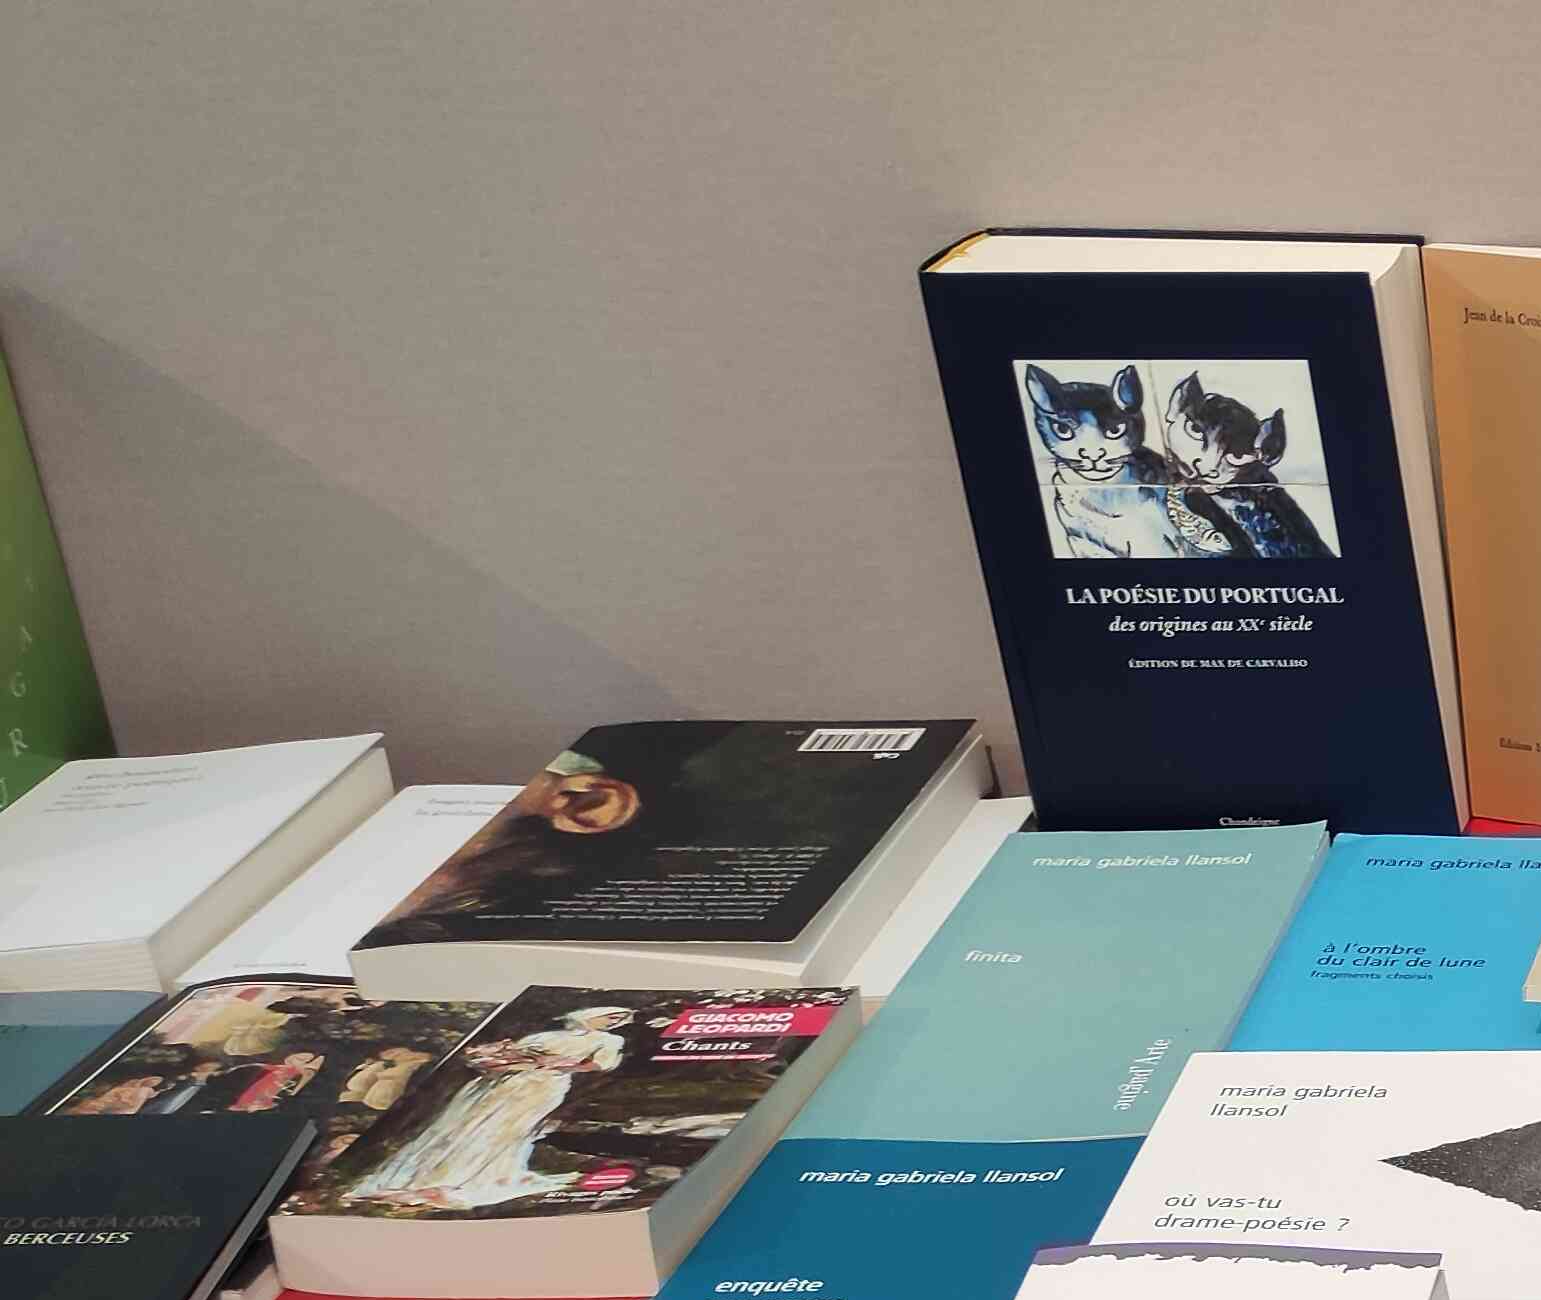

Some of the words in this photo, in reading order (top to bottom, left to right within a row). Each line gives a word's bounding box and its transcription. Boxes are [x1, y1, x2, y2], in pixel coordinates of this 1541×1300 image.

[1066, 588, 1097, 603] LA
[1100, 584, 1181, 603] POÉSIE
[1184, 588, 1216, 603] DU
[1221, 587, 1344, 603] PORTUGAL
[1033, 855, 1089, 866] maria
[1097, 854, 1179, 870] gabriela
[1186, 853, 1252, 866] llansol
[1322, 943, 1335, 954] à
[1344, 943, 1426, 955] l'ombre
[964, 950, 1023, 963] finita
[1317, 956, 1343, 966] du
[1353, 956, 1398, 967] clair
[1406, 956, 1431, 967] de
[1439, 956, 1487, 967] lune
[688, 1012, 794, 1023] GIACOMO
[676, 1023, 792, 1034] LEOPARDI
[663, 1039, 752, 1052] Chants
[1219, 1085, 1286, 1098] maria
[1294, 1084, 1388, 1101] gabriela
[1210, 1104, 1287, 1118] llansol
[800, 1168, 870, 1183] maria
[875, 1168, 976, 1186] gabriela
[983, 1168, 1064, 1183] llansol
[1164, 1194, 1196, 1208] où
[1206, 1197, 1281, 1210] vas-tu
[1154, 1214, 1326, 1232] drame-poésie
[3, 1232, 134, 1245] BERCEUSES
[715, 1277, 823, 1295] enquête
